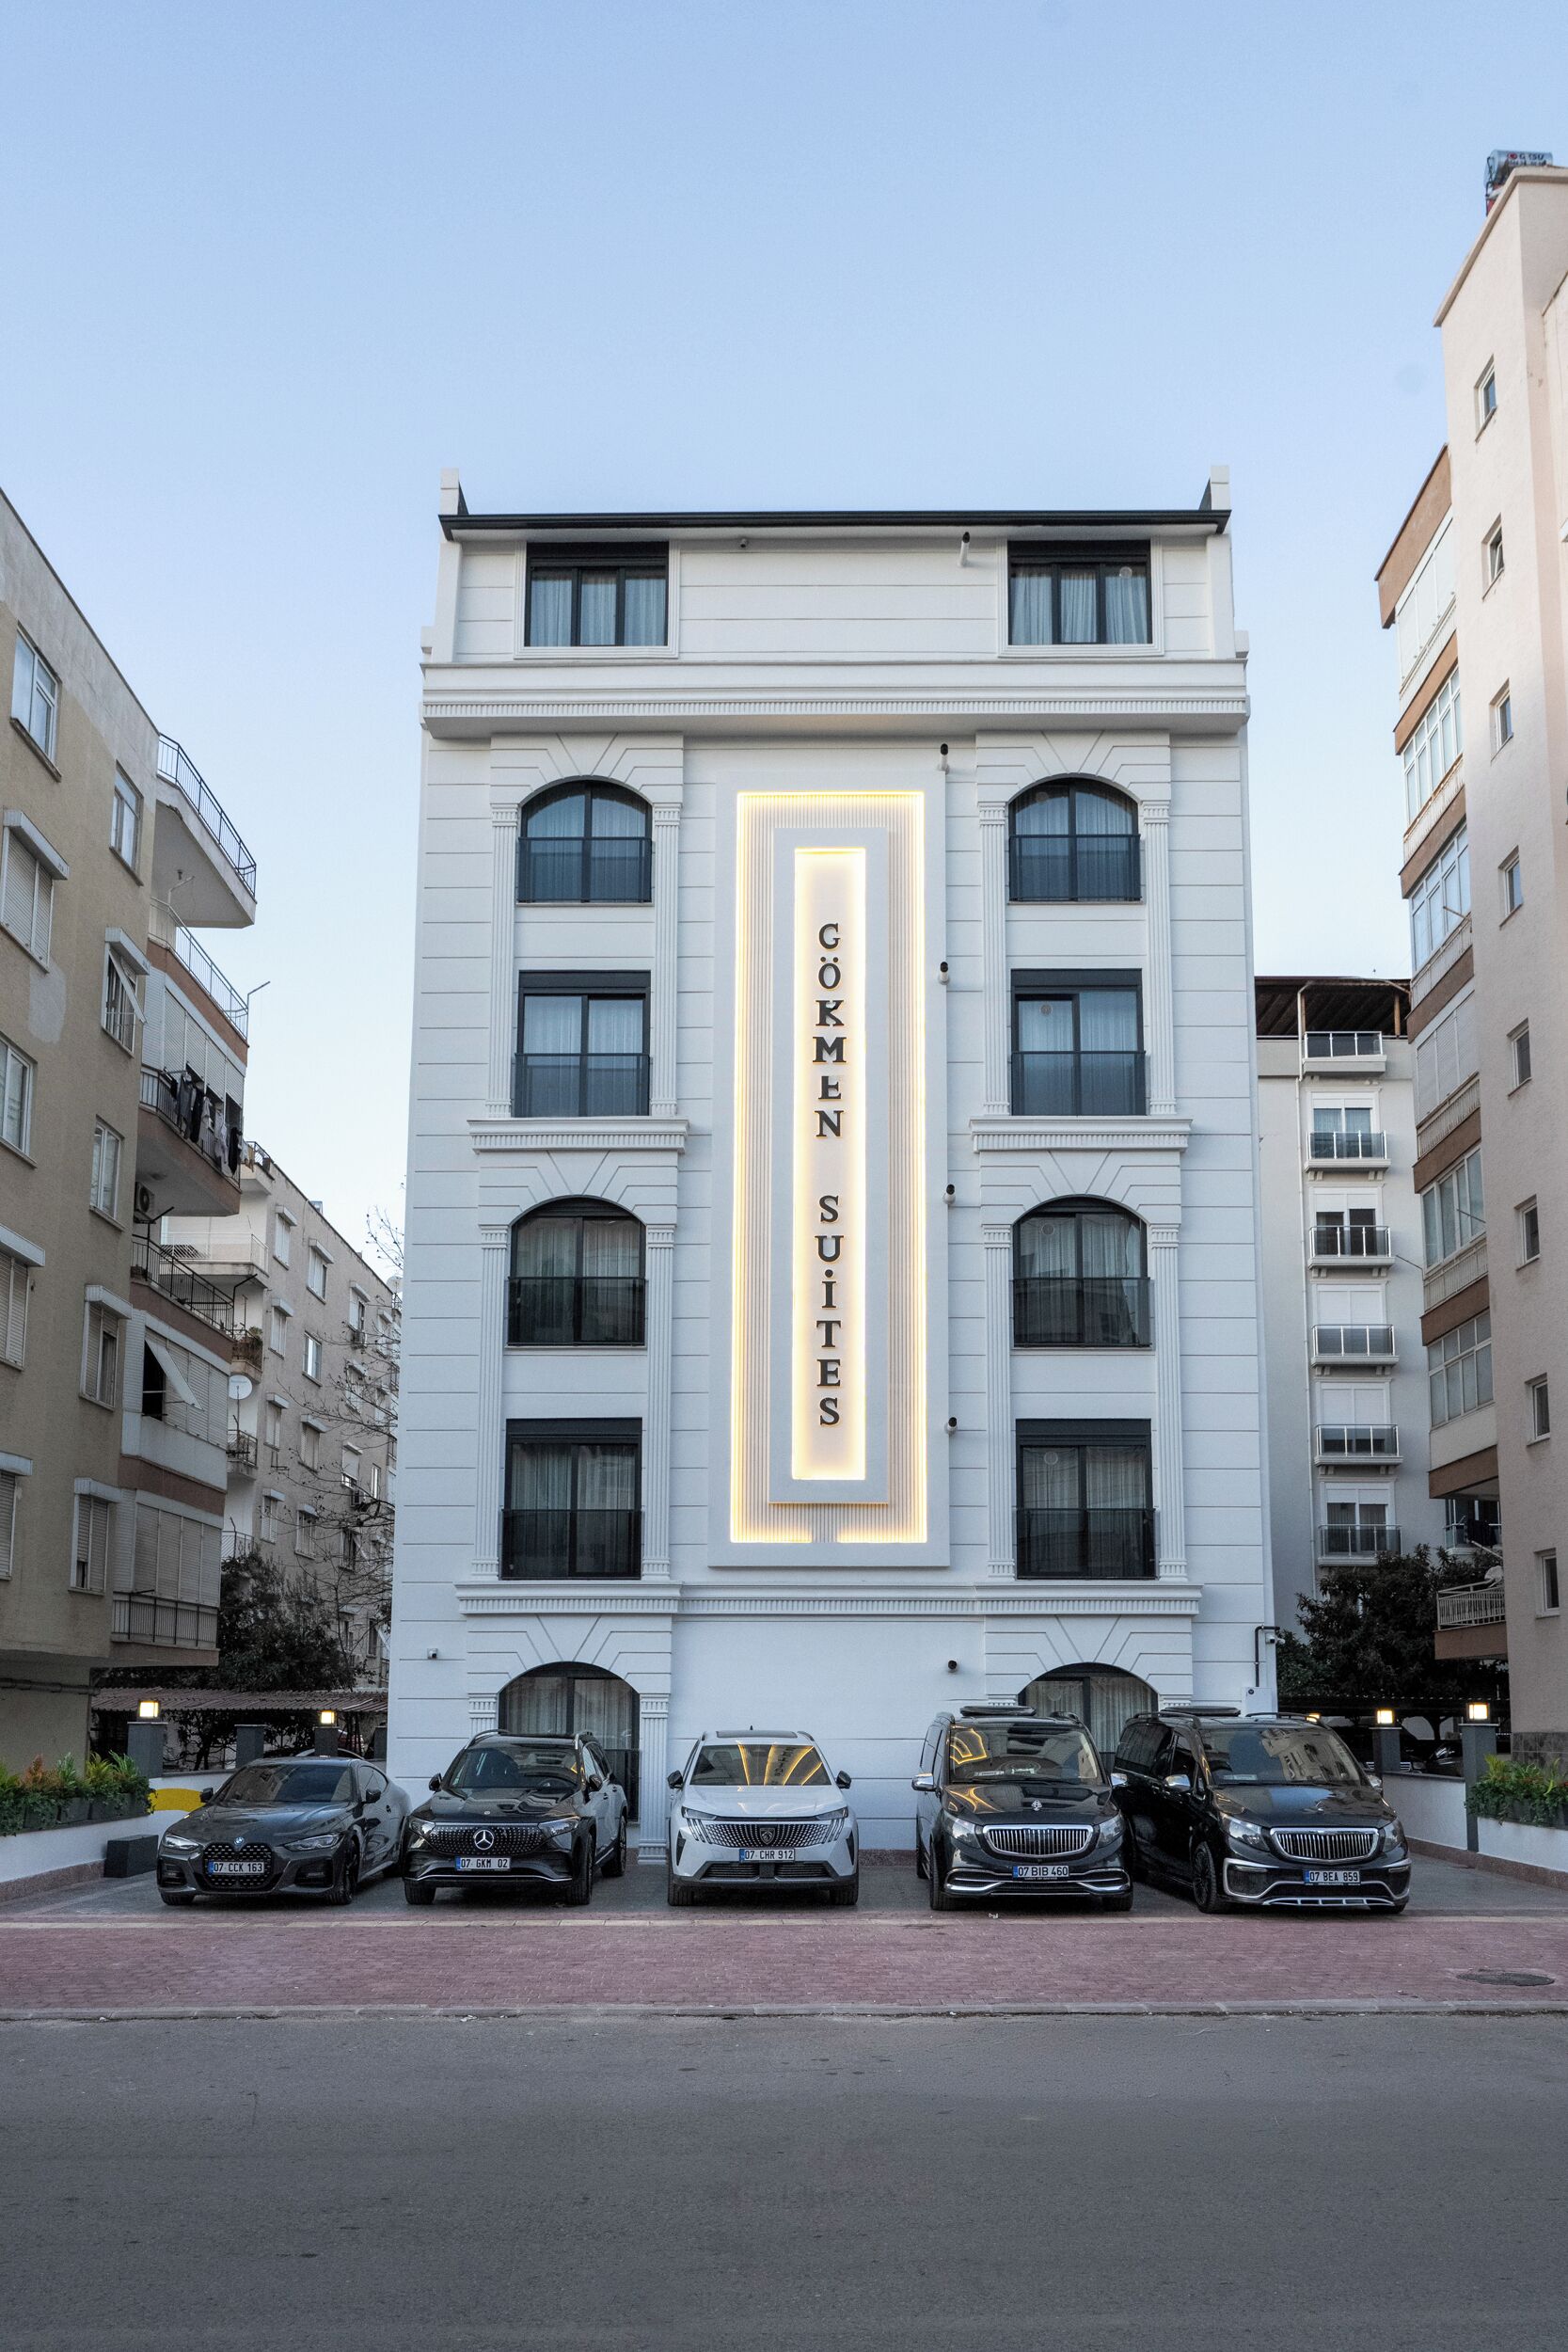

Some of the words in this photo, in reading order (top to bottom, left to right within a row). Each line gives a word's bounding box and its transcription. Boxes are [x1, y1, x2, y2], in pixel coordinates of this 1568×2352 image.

[812, 923, 847, 1137] GÖKMEN
[745, 1851, 755, 1860] 07
[759, 1851, 775, 1860] CHR
[778, 1850, 793, 1859] 912
[214, 1863, 224, 1872] 07
[228, 1863, 244, 1872] CCK
[247, 1863, 262, 1872] 163
[461, 1858, 471, 1868] 07
[476, 1858, 492, 1868] GKM
[498, 1858, 508, 1868] 02
[1018, 1867, 1029, 1877] 07
[1031, 1867, 1049, 1877] BIB
[1051, 1866, 1069, 1876] 460
[1309, 1871, 1320, 1882] 07
[1323, 1871, 1339, 1882] BEA
[1342, 1871, 1358, 1882] 859
